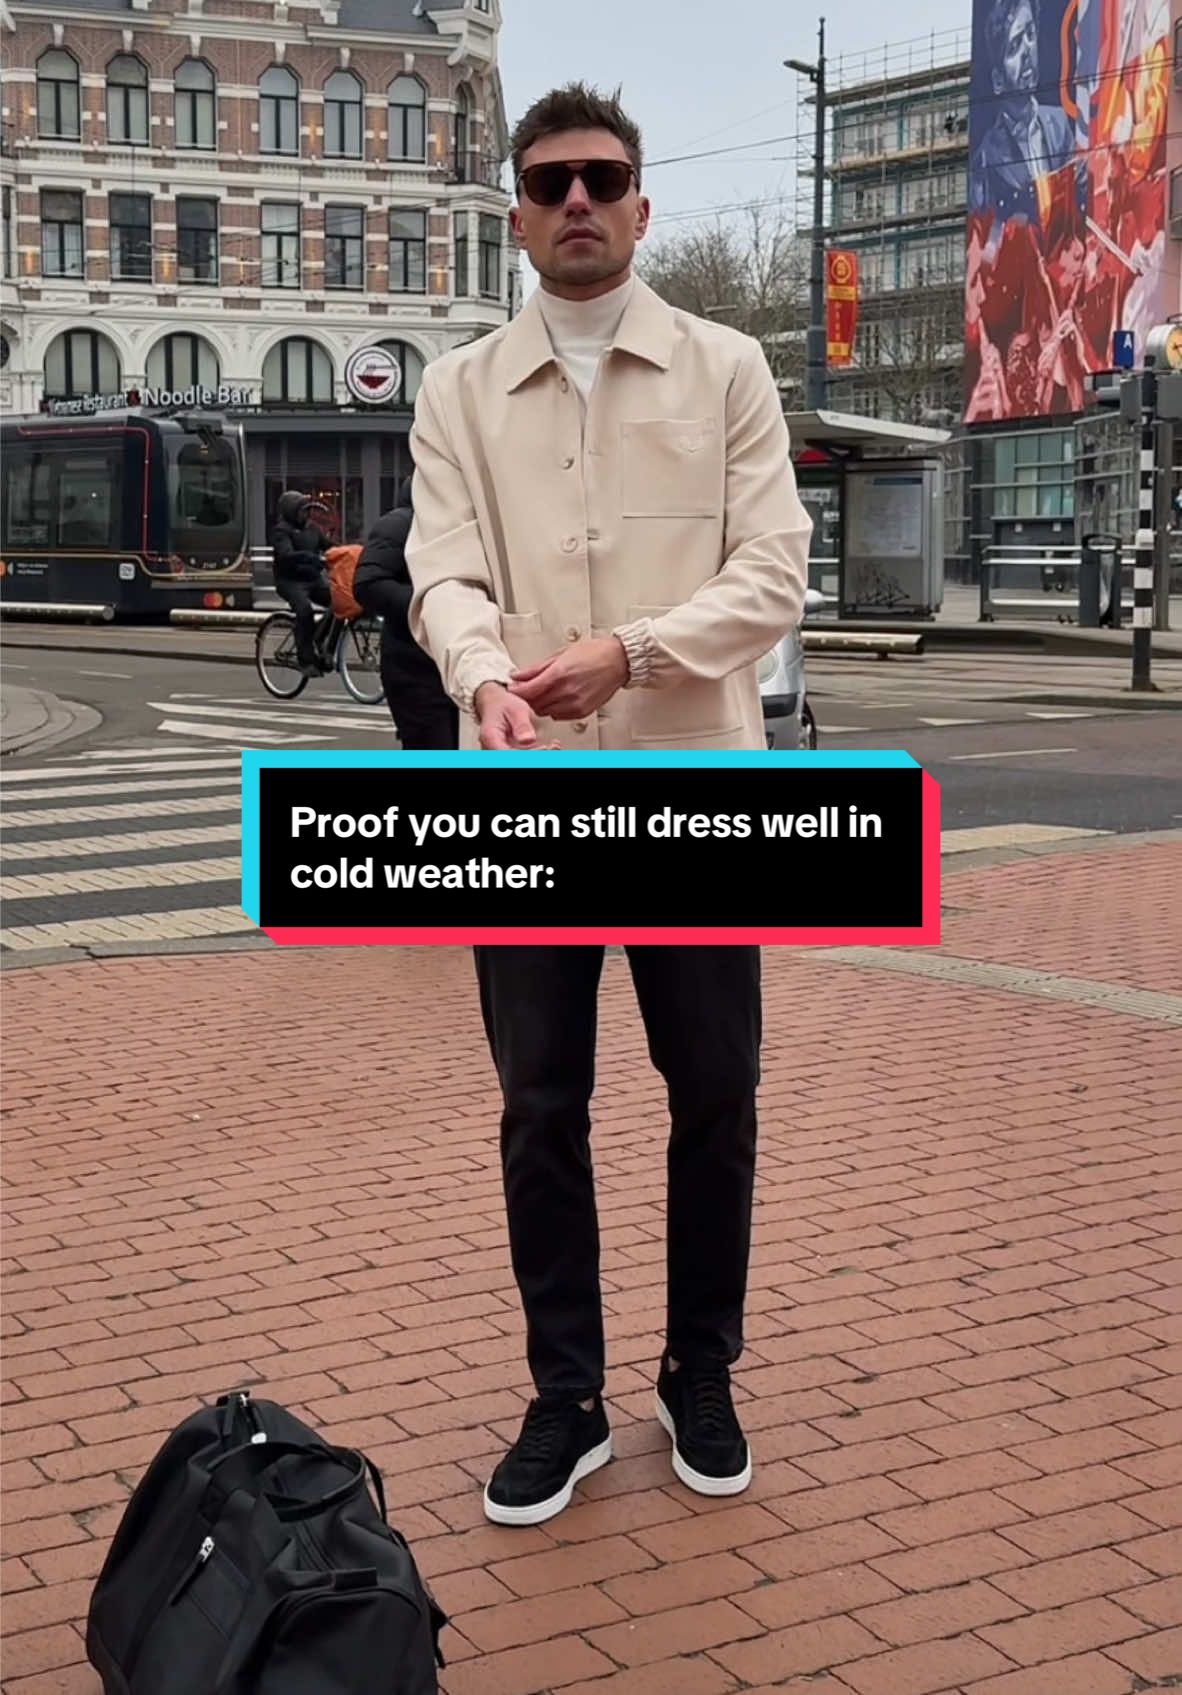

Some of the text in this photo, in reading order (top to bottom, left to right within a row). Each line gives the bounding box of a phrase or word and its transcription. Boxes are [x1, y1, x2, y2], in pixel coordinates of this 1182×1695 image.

[1123, 333, 1133, 349] A
[145, 384, 252, 406] Noodle Bar
